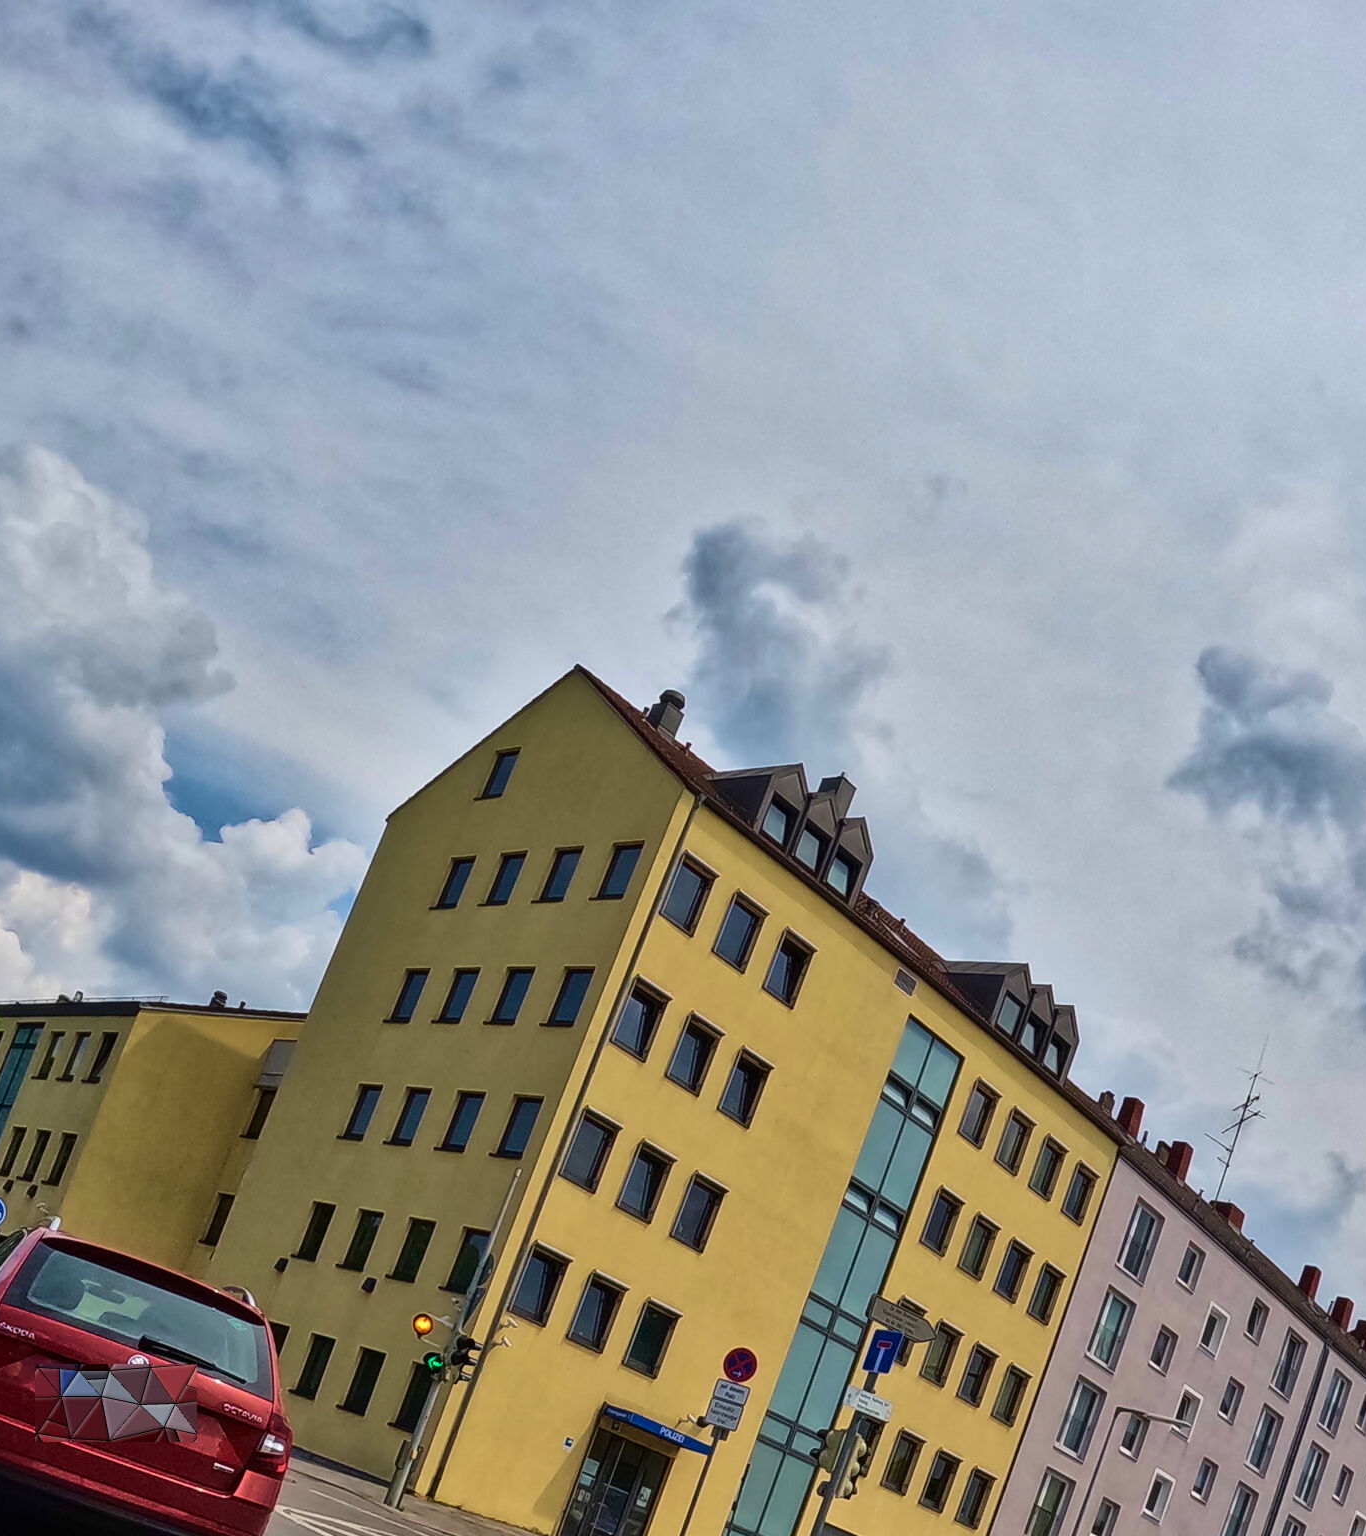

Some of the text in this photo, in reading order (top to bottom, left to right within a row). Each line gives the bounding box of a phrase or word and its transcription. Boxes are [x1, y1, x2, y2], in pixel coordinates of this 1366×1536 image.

[0, 1321, 36, 1340] ŠKODA
[223, 1403, 263, 1423] OCTAVIA
[659, 1426, 685, 1444] POLIZEI
